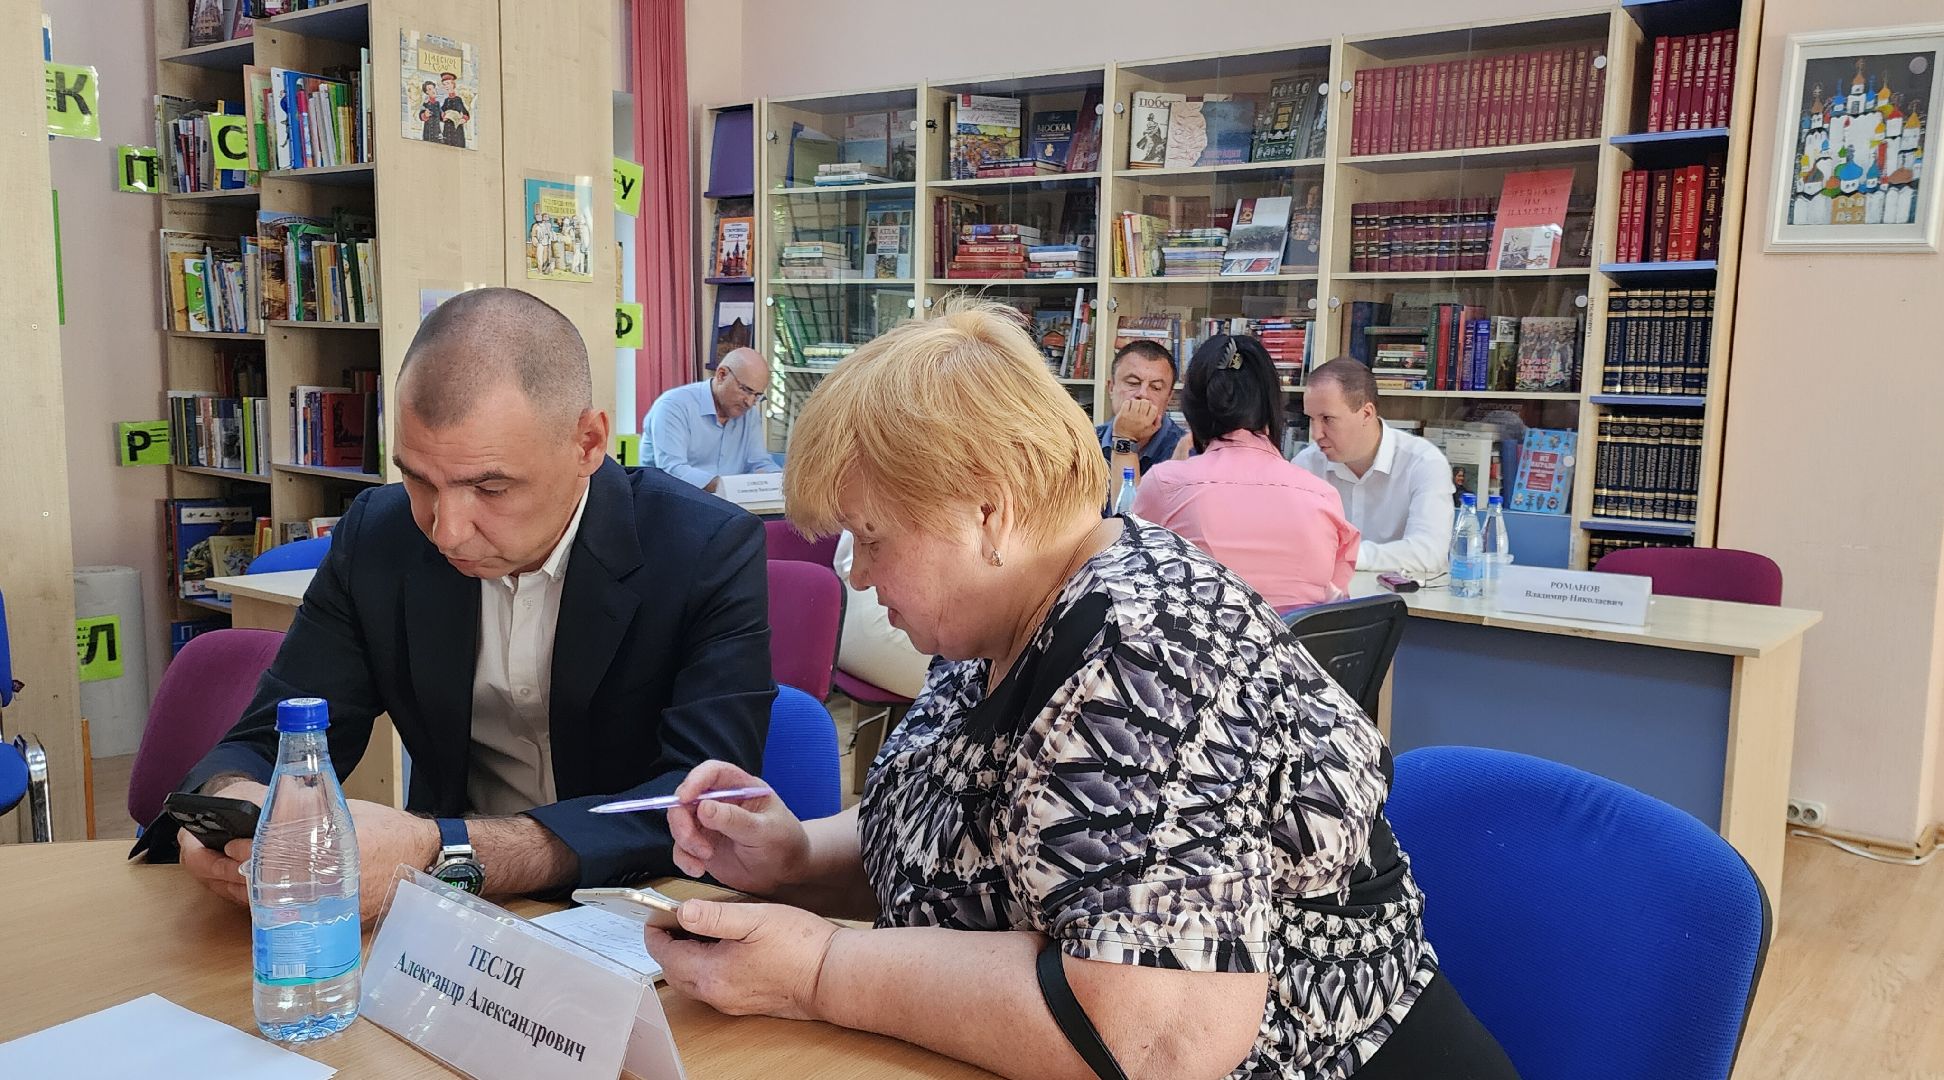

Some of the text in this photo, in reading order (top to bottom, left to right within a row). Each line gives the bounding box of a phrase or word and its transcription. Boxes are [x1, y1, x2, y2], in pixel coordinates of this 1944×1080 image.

[55, 71, 92, 115] К
[217, 125, 248, 160] С
[1037, 122, 1072, 133] МОСКВА
[125, 154, 155, 188] П
[127, 430, 151, 462] Р
[1525, 589, 1624, 607] Владимир Николаевич
[1550, 581, 1601, 593] РОМАНОВ
[80, 622, 117, 666] Л
[467, 944, 527, 990] ТЕСЛЯ
[393, 951, 587, 1063] Александр Александрович
